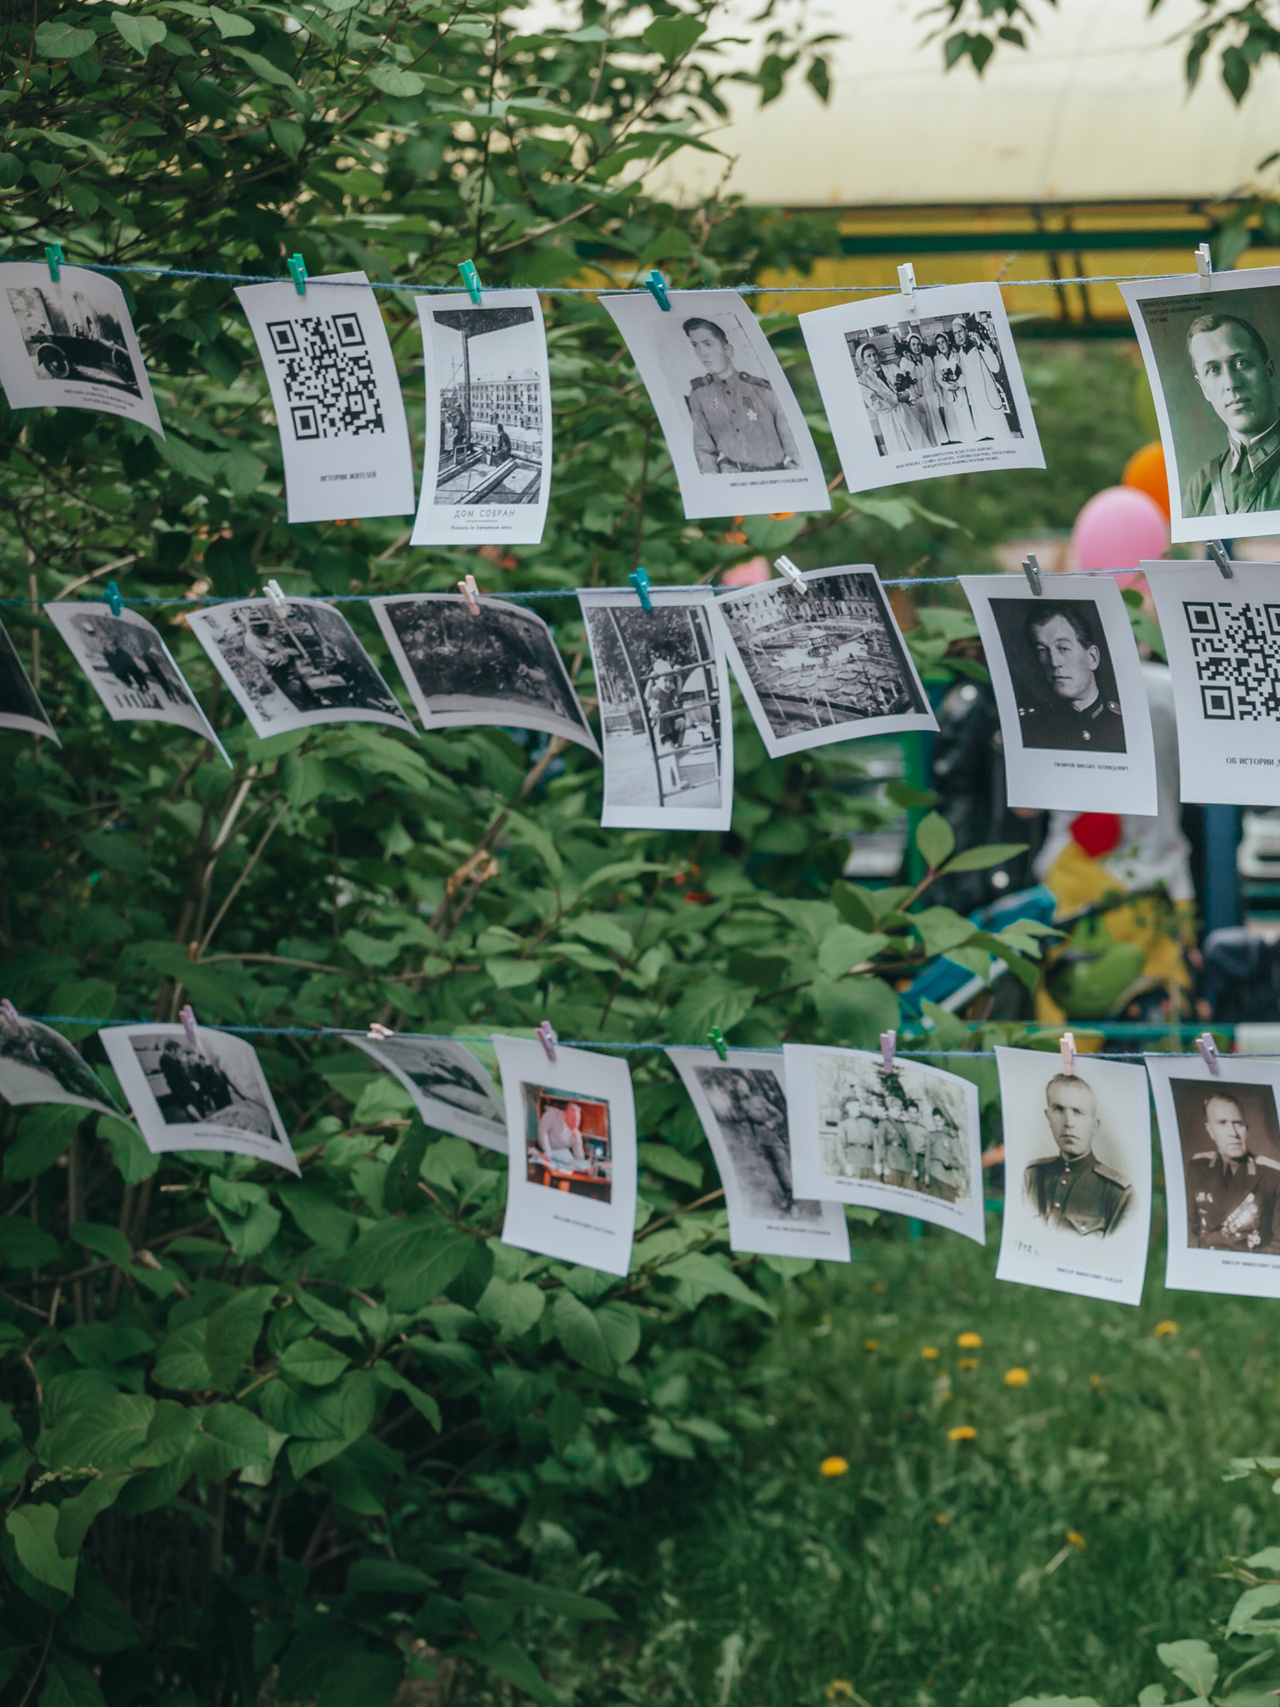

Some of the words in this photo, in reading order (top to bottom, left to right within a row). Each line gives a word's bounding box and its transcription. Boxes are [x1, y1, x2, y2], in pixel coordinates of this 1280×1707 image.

[454, 510, 475, 518] ДОМ
[480, 509, 515, 518] СОБРАН
[1239, 757, 1274, 766] ИСТОРИИ
